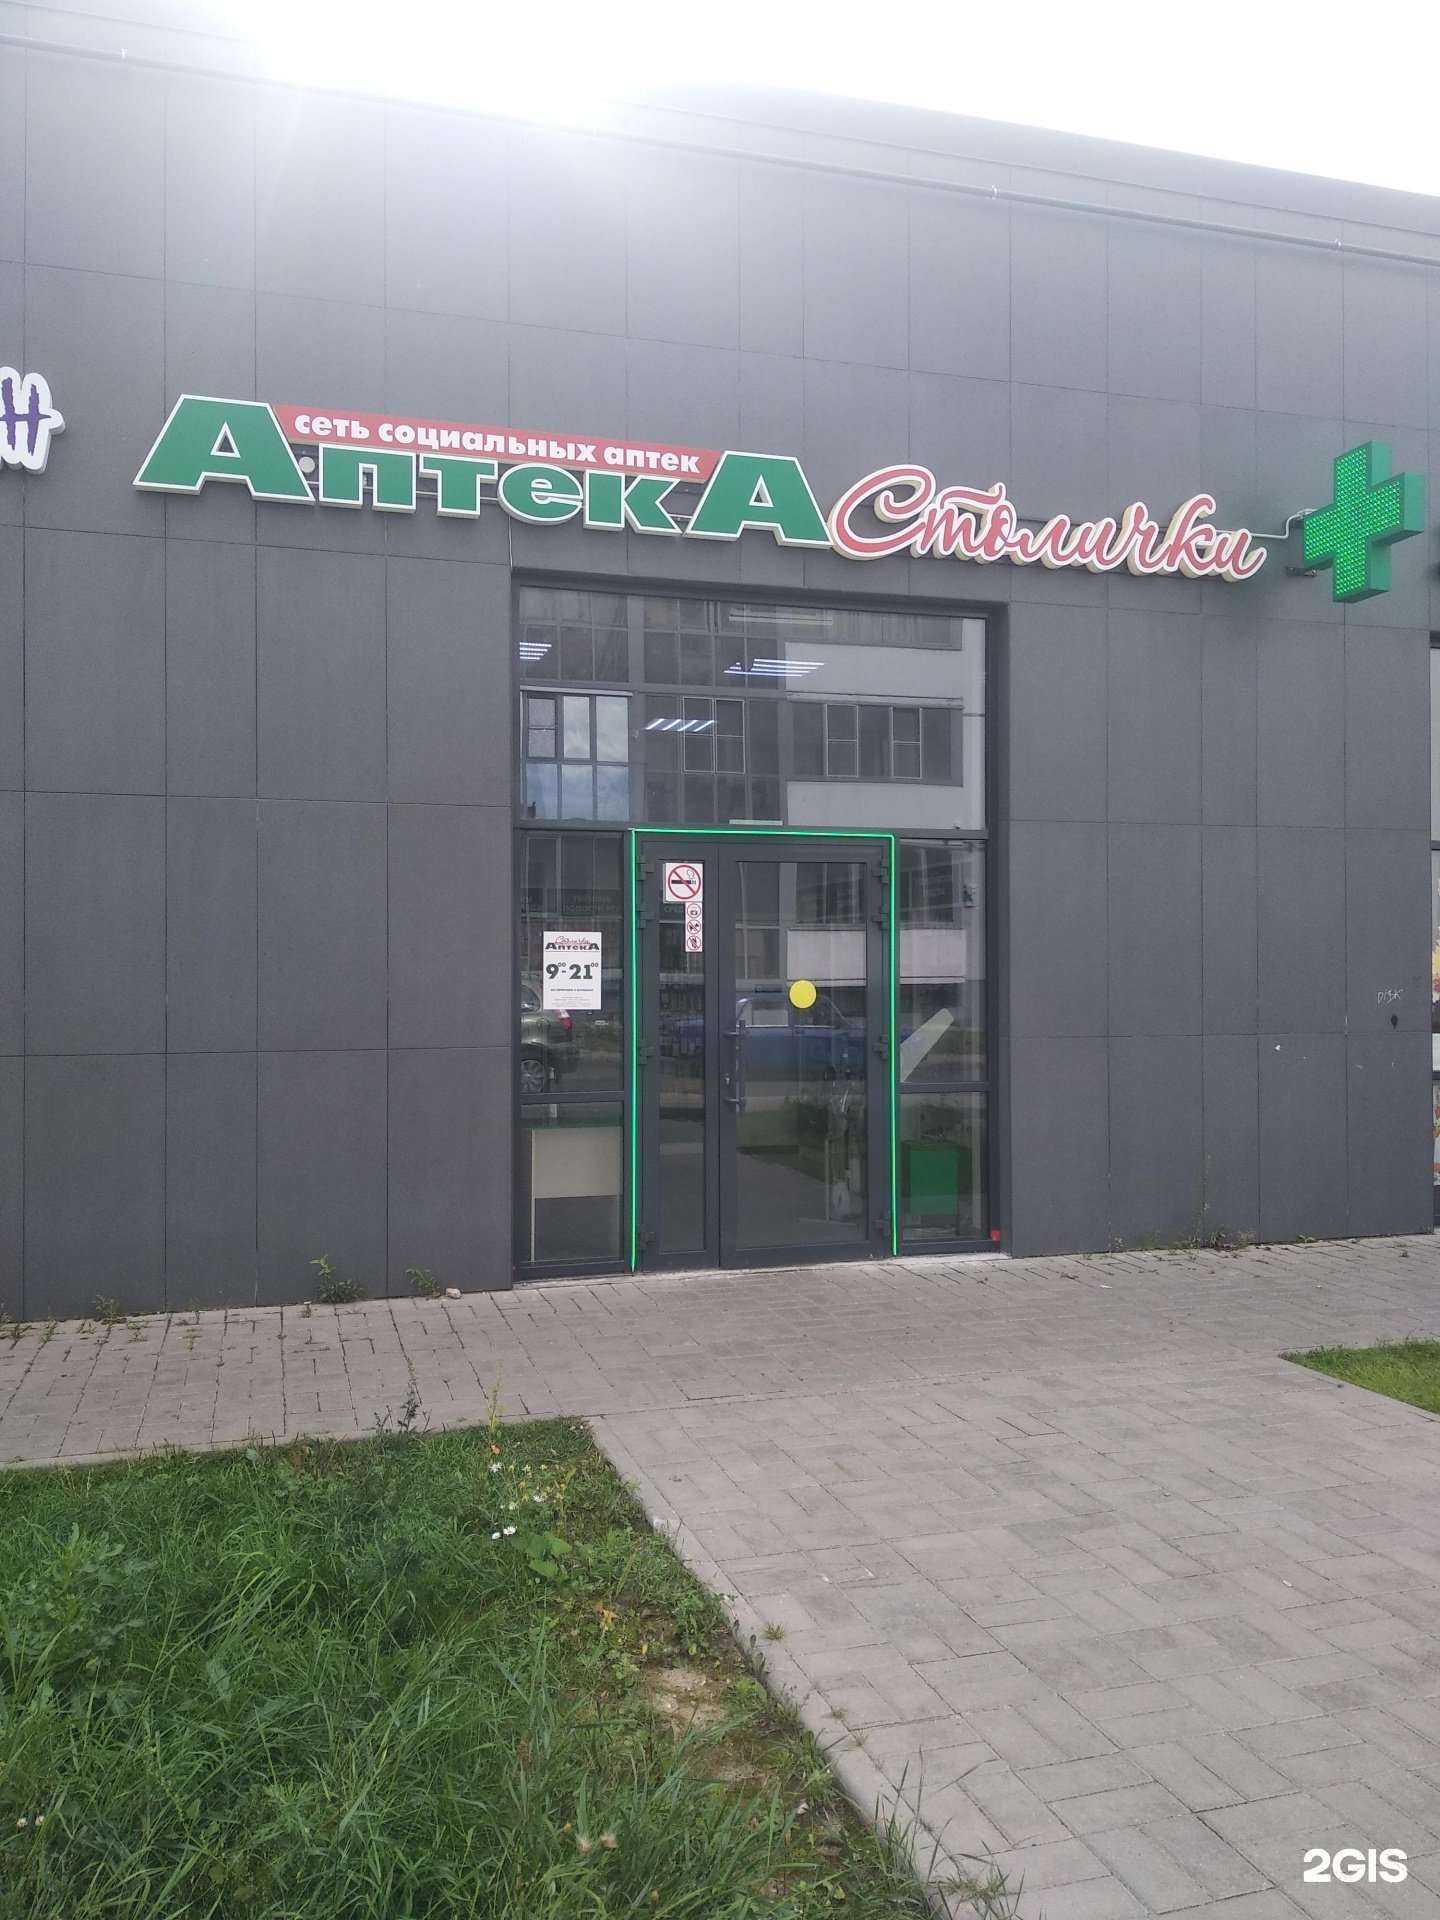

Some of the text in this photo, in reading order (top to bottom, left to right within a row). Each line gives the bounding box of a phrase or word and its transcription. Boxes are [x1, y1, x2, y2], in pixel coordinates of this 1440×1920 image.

[295, 414, 701, 474] сеть социальных аптек
[828, 463, 1268, 583] Столички
